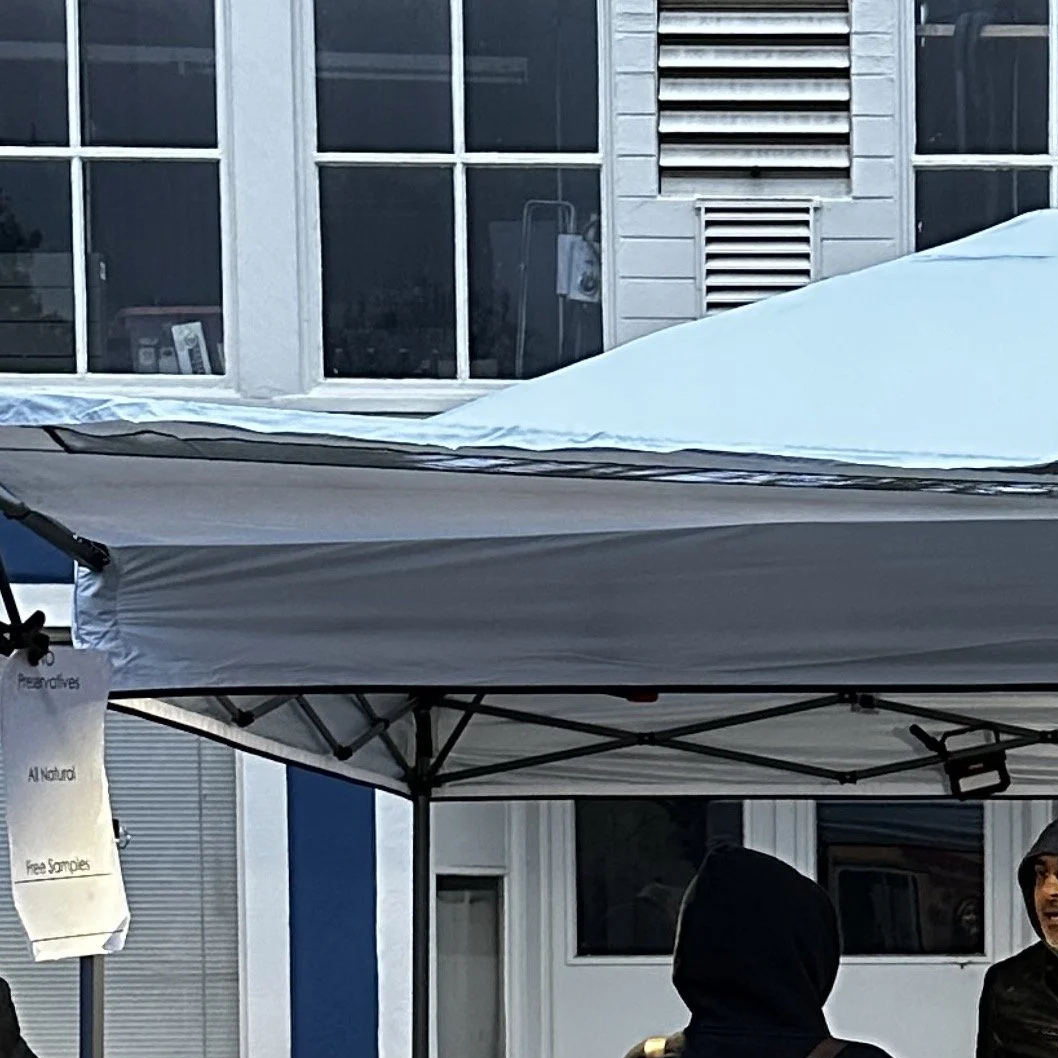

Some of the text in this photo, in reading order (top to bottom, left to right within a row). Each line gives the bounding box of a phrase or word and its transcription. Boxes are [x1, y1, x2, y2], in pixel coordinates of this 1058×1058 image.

[28, 766, 76, 782] All Natural
[26, 857, 90, 875] Free Samples
